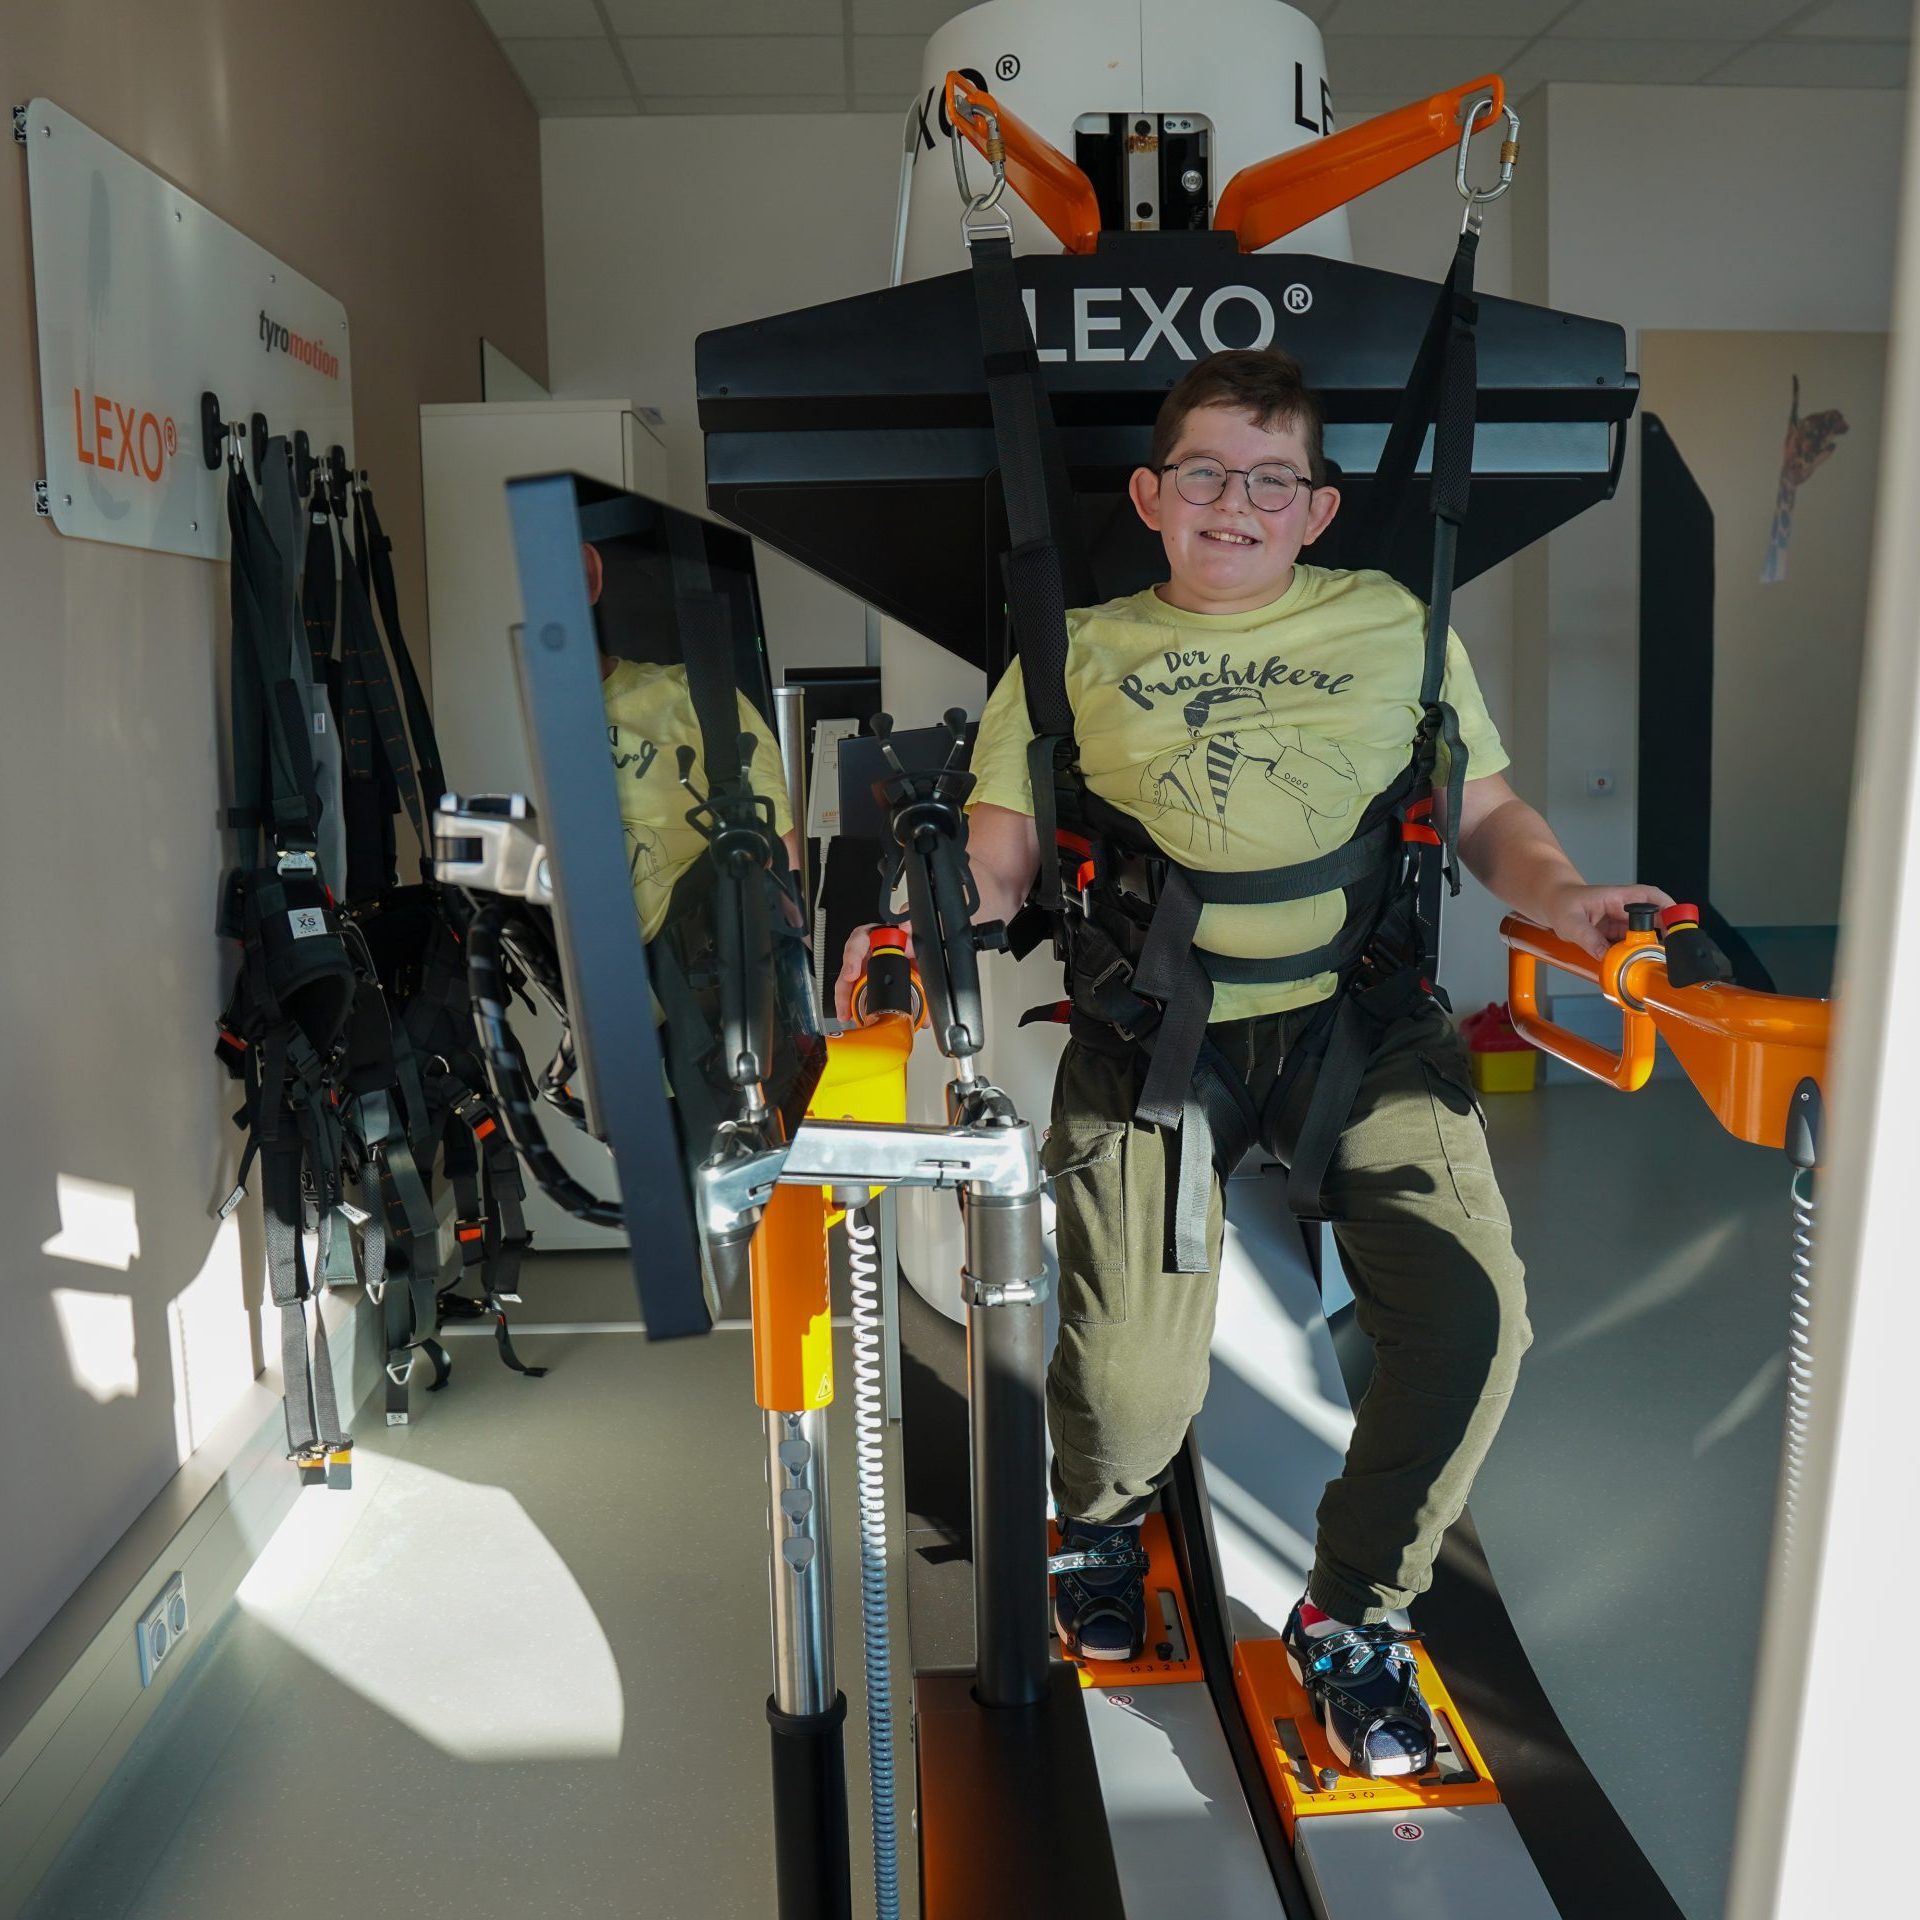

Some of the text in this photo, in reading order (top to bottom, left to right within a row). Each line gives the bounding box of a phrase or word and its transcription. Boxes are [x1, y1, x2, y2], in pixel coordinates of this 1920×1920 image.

[259, 310, 339, 380] tyromotion
[1118, 653, 1354, 711] Prachtkerl
[1163, 649, 1211, 674] Der
[299, 917, 316, 928] XS
